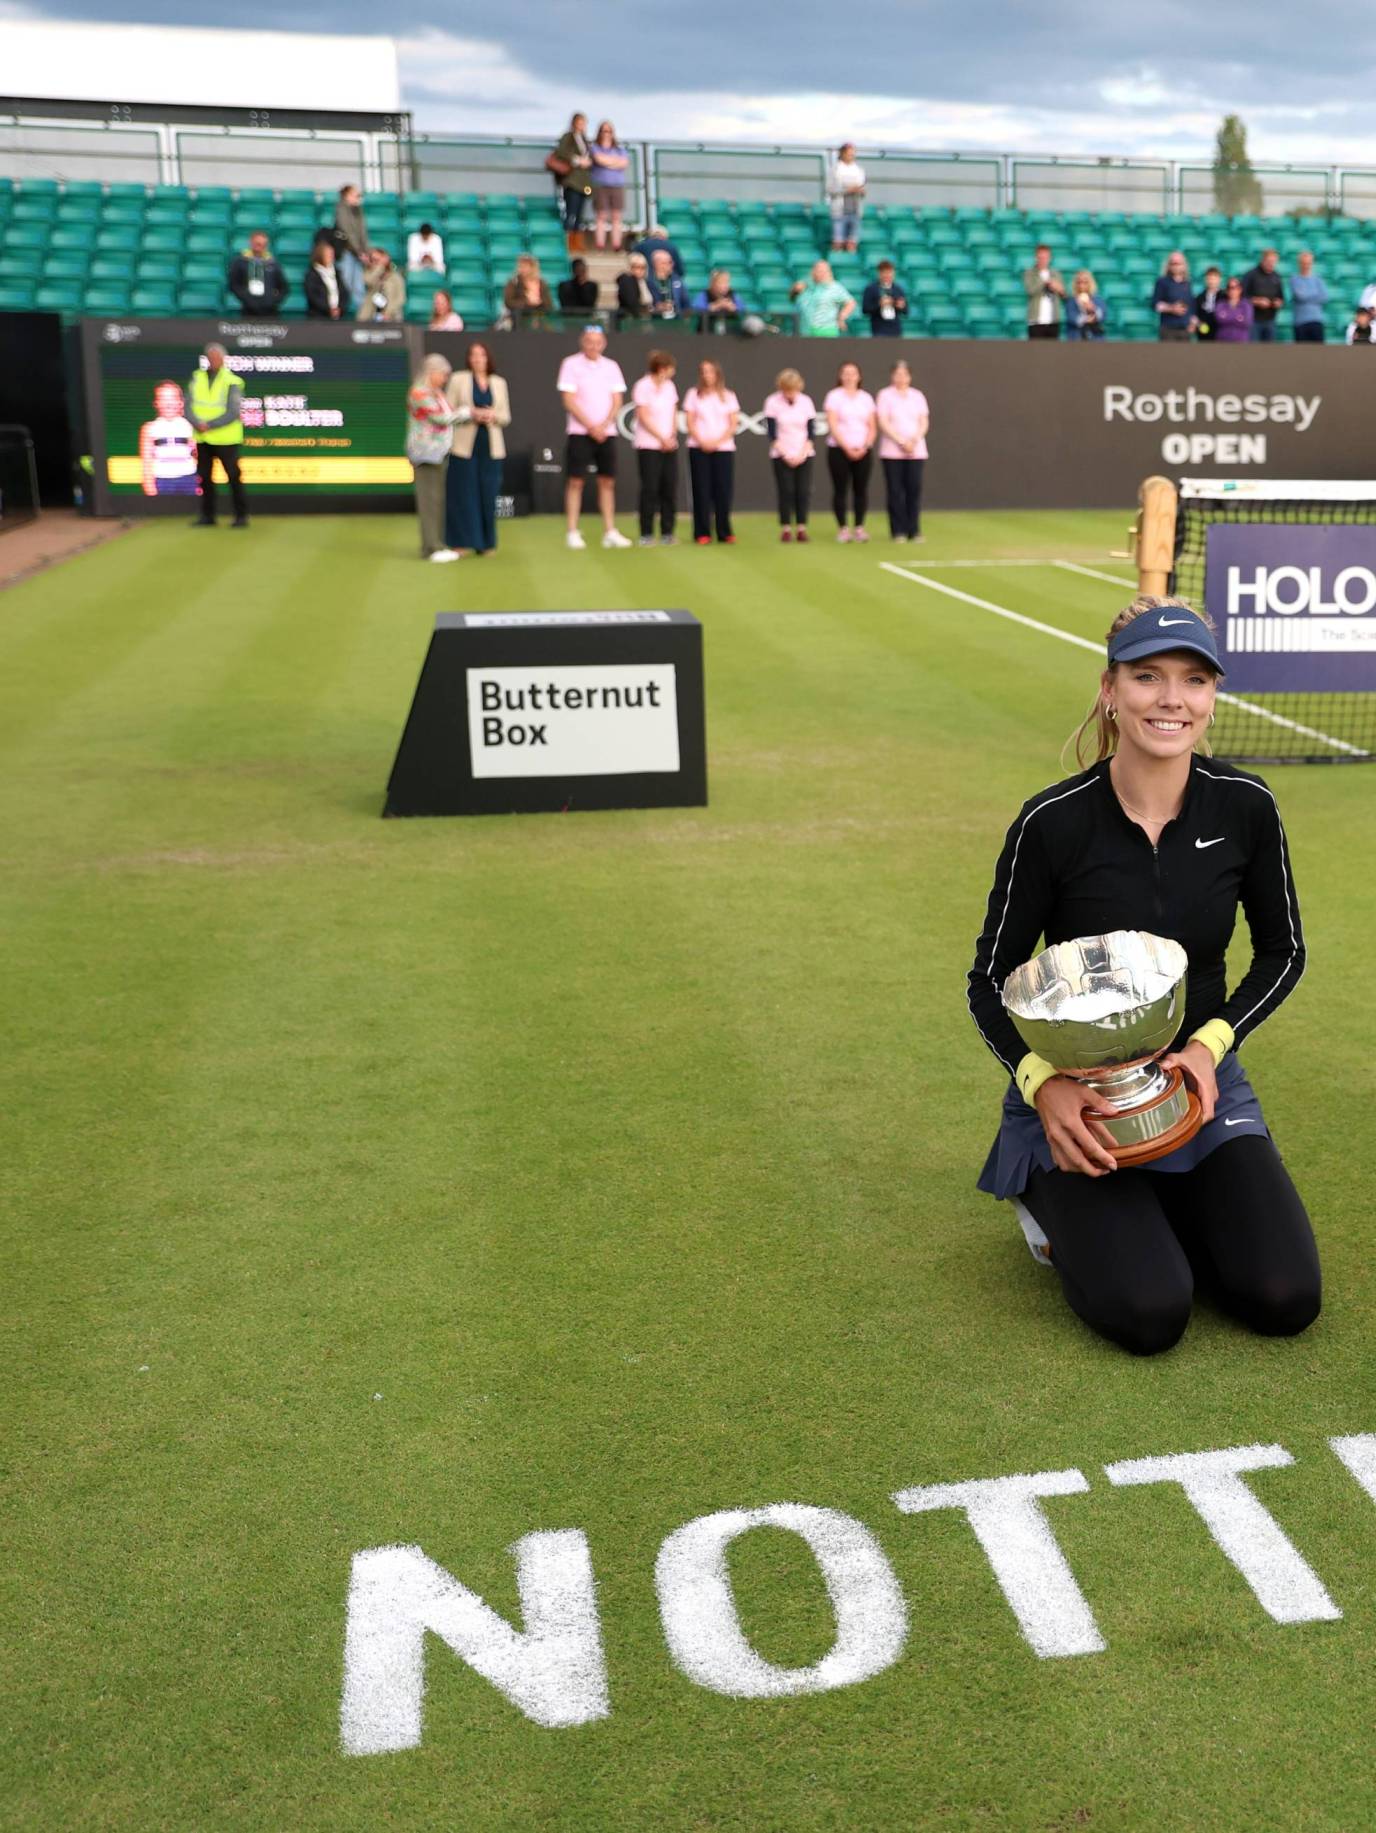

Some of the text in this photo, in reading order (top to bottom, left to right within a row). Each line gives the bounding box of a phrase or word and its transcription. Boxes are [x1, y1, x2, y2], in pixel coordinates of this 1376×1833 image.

[1104, 386, 1322, 431] Rothesay
[1162, 433, 1266, 464] OPEN
[1321, 628, 1345, 640] The
[481, 681, 661, 711] Butternut
[483, 717, 548, 746] Box
